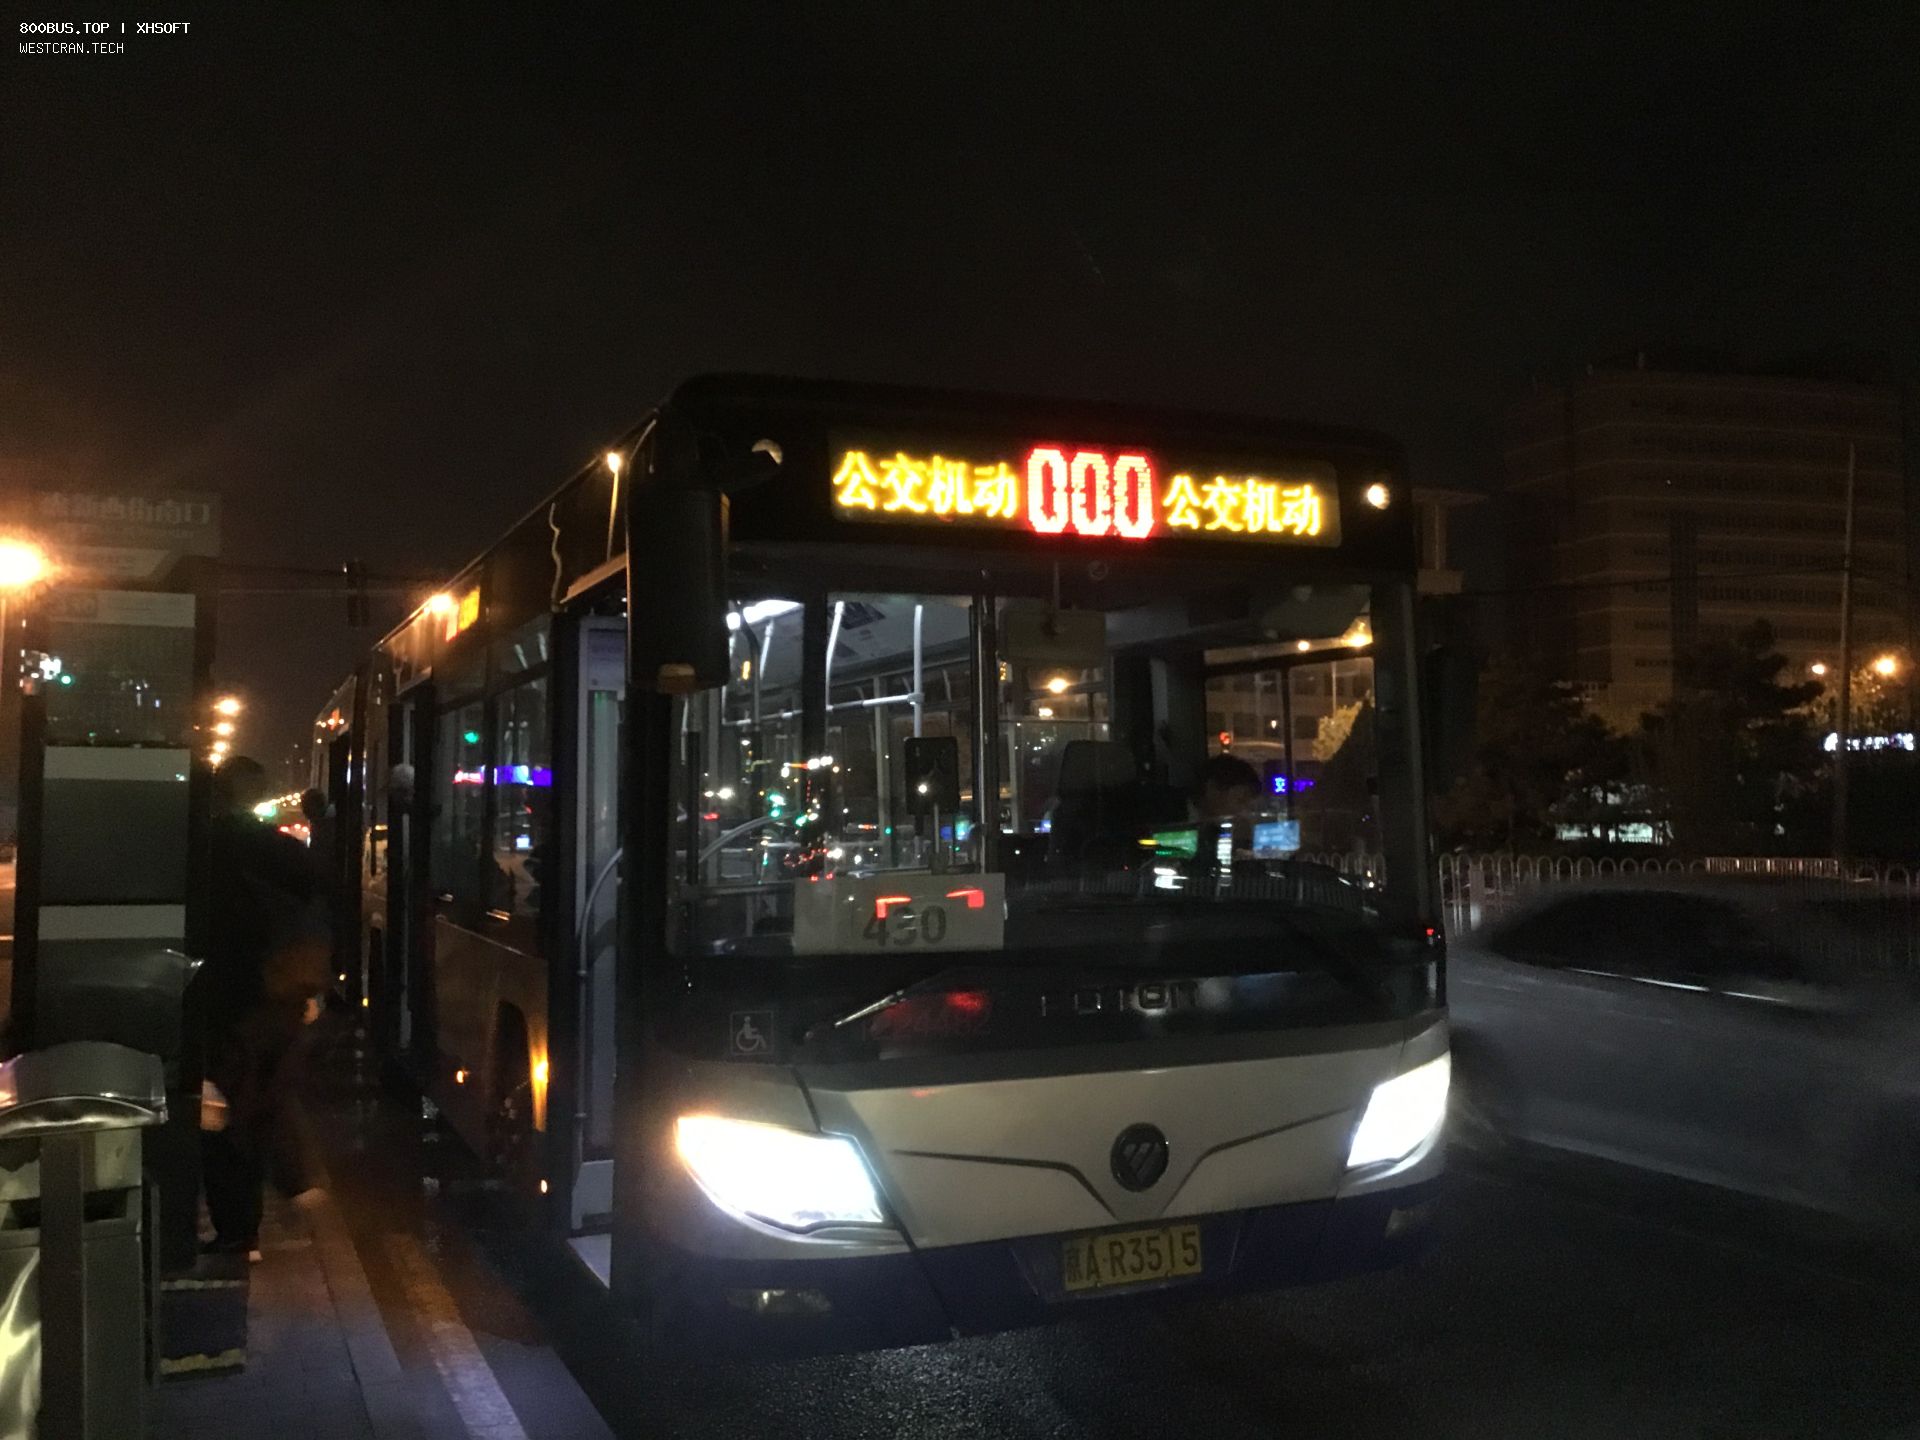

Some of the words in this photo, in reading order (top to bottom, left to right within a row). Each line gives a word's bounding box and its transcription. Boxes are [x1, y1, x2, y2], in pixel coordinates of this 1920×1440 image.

[833, 450, 1018, 518] 公交机动
[1026, 447, 1154, 539] 000
[1162, 474, 1323, 537] 公交机动
